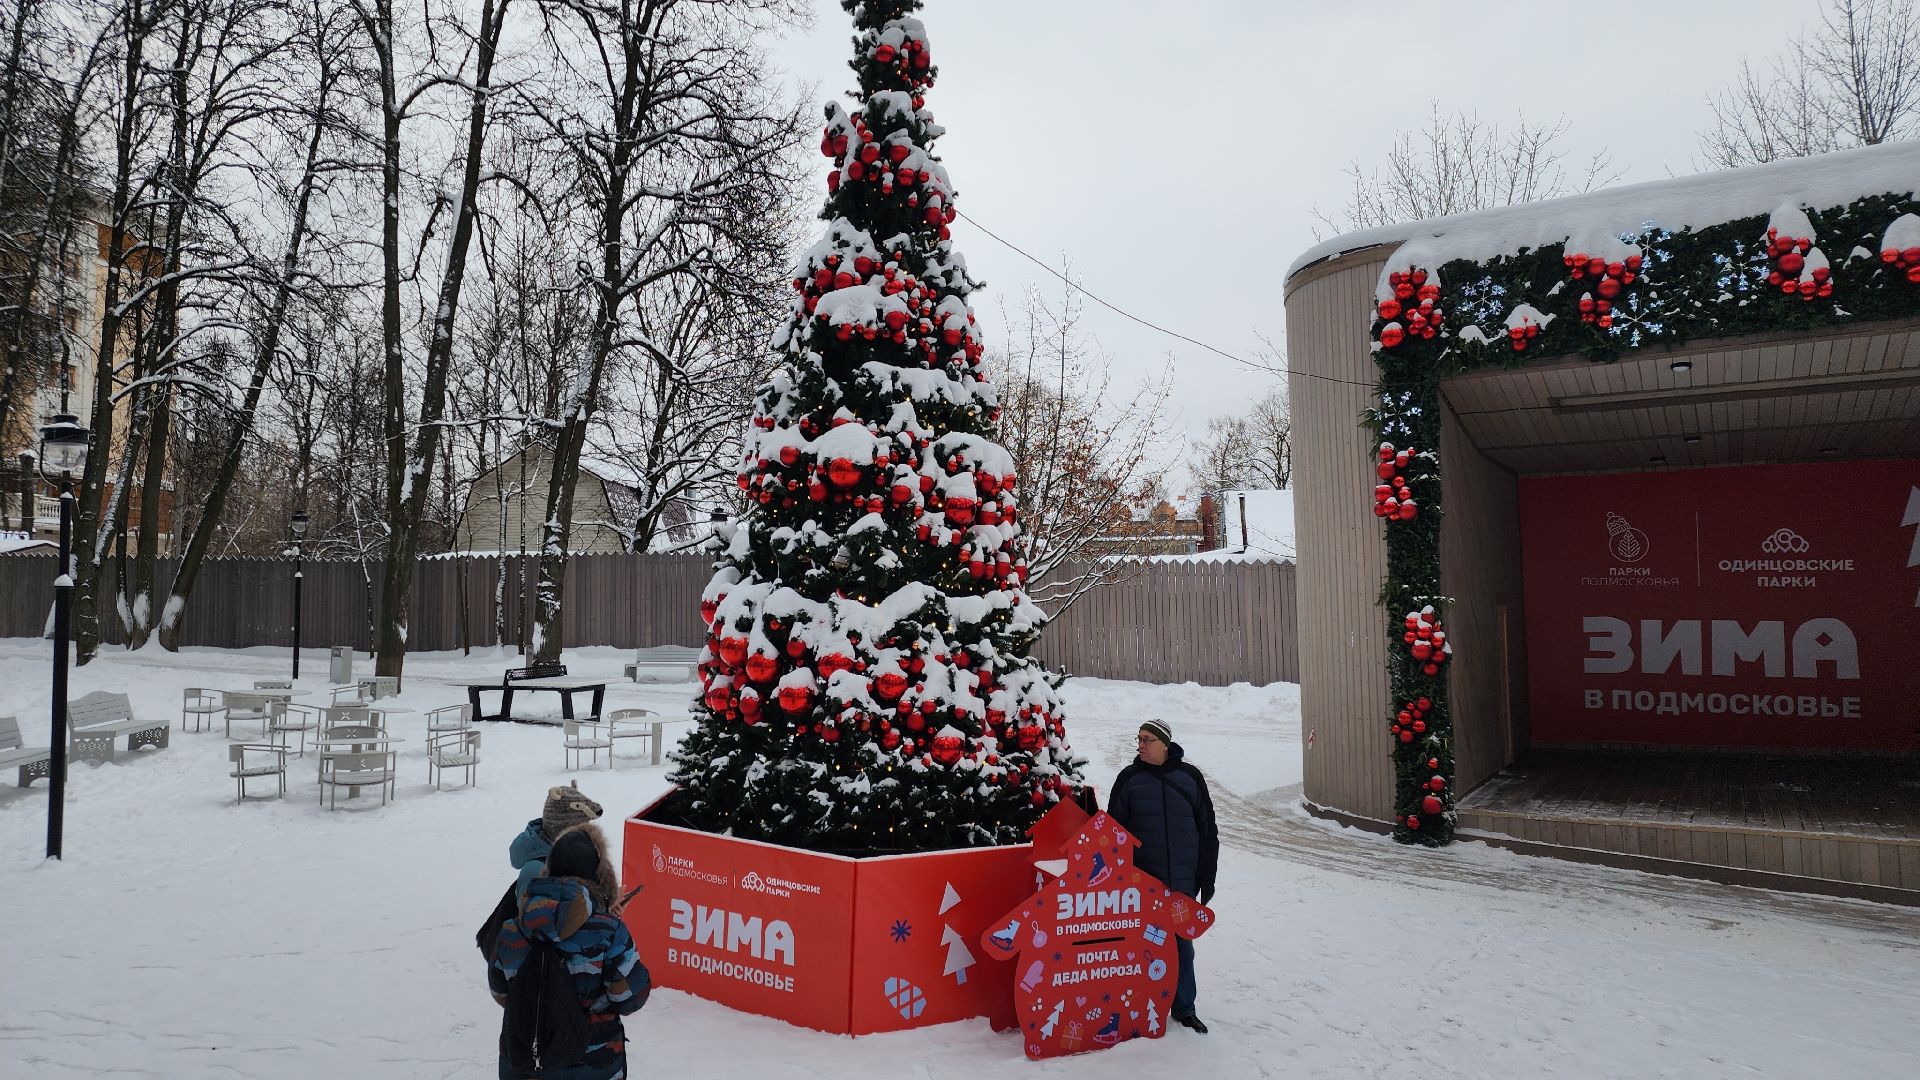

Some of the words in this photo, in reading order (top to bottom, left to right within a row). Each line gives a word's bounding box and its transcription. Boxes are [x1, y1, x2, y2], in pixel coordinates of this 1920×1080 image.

[1609, 567, 1651, 576] ПАРКИ
[1718, 559, 1855, 573] ОДИНЦОВСКИЕ
[1757, 576, 1816, 588] ПАРКИ
[1582, 616, 1861, 679] ЗИМА
[1584, 689, 1604, 709] В
[1612, 690, 1861, 719] ПОДМОСКОВЬЕ
[668, 856, 694, 869] ПАРКИ
[667, 865, 728, 886] ПОДМОСКОВЬЯ
[766, 876, 821, 895] ОДИНЦОВСКИЕ
[766, 886, 790, 898] ПАРКИ
[1056, 888, 1141, 920] ЗИМА
[669, 898, 795, 966] ЗИМА
[1056, 926, 1064, 936] В
[1065, 919, 1141, 935] ПОДМОСКОВЬЕ
[1077, 950, 1119, 965] ПОЧТА
[668, 948, 678, 963] В
[681, 951, 795, 992] ПОДМОСКОВЬЕ
[1052, 970, 1088, 987] ДЕДА
[1091, 964, 1142, 980] МОРОЗА
